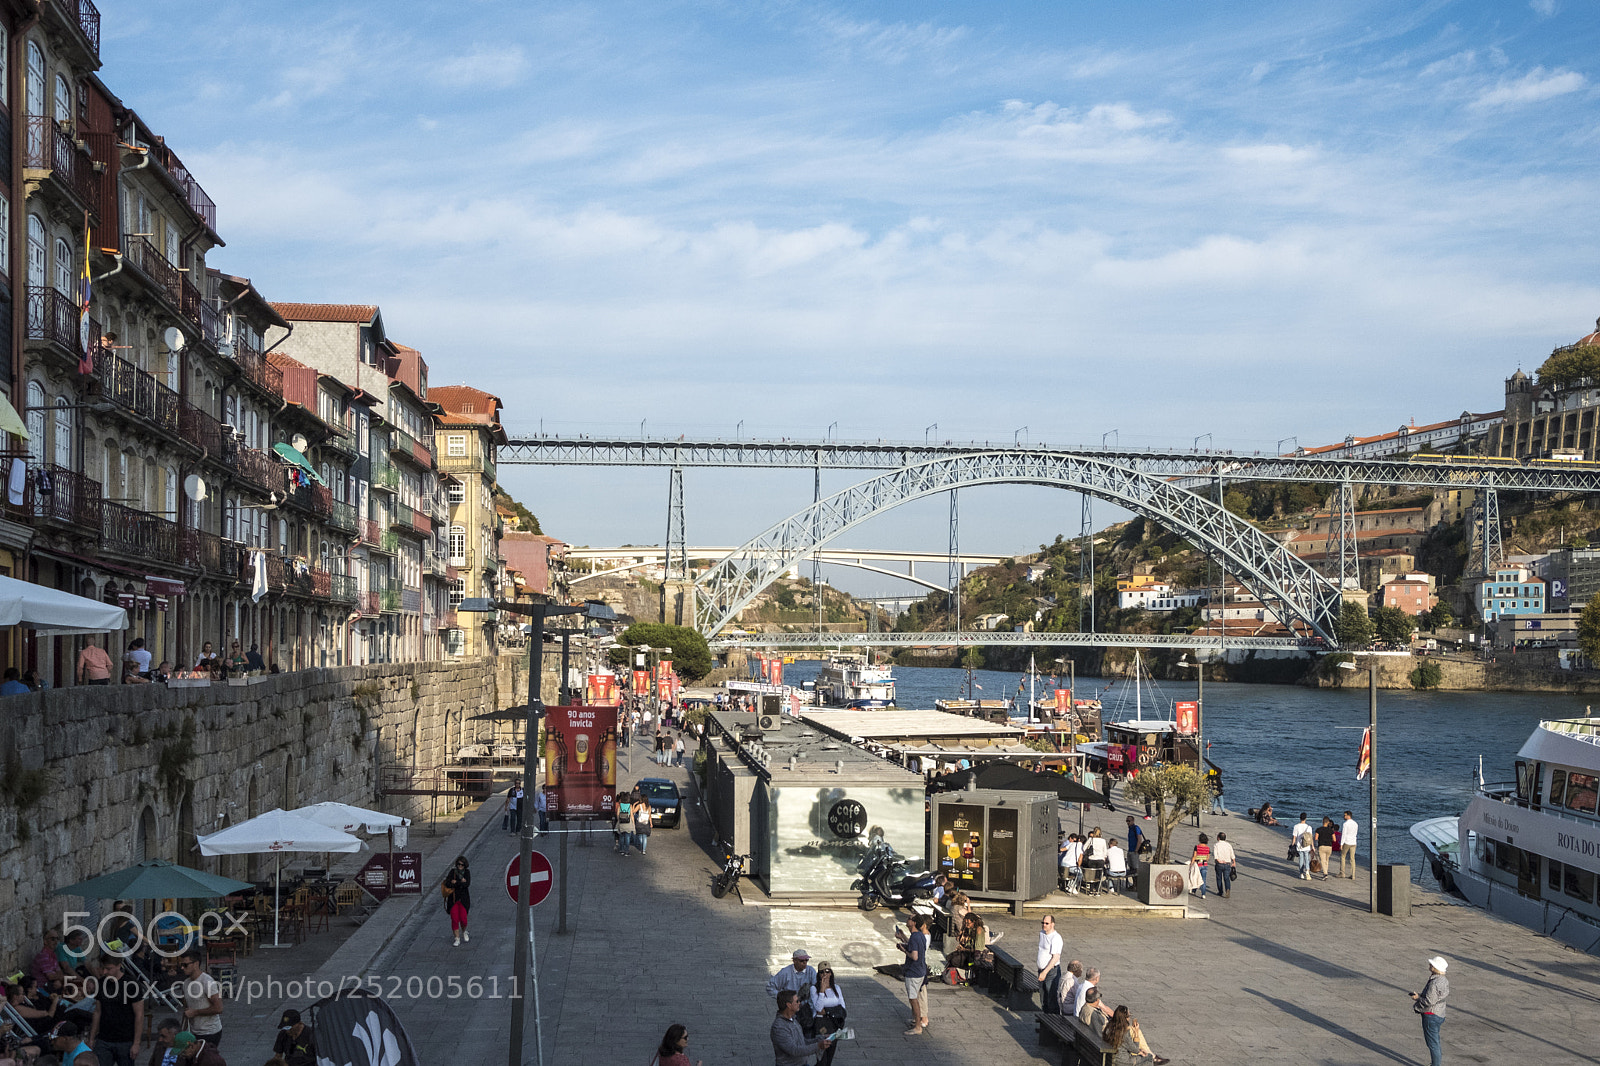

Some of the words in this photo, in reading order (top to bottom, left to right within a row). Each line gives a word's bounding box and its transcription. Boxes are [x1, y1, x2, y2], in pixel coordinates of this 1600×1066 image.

[1552, 581, 1562, 597] P
[1526, 620, 1533, 629] P
[567, 710, 577, 719] 90
[578, 711, 596, 719] anos
[1108, 753, 1123, 762] CRUZ
[837, 821, 861, 834] cais
[1558, 832, 1580, 853] ROTA
[1582, 839, 1595, 857] DO
[399, 869, 415, 880] UVA
